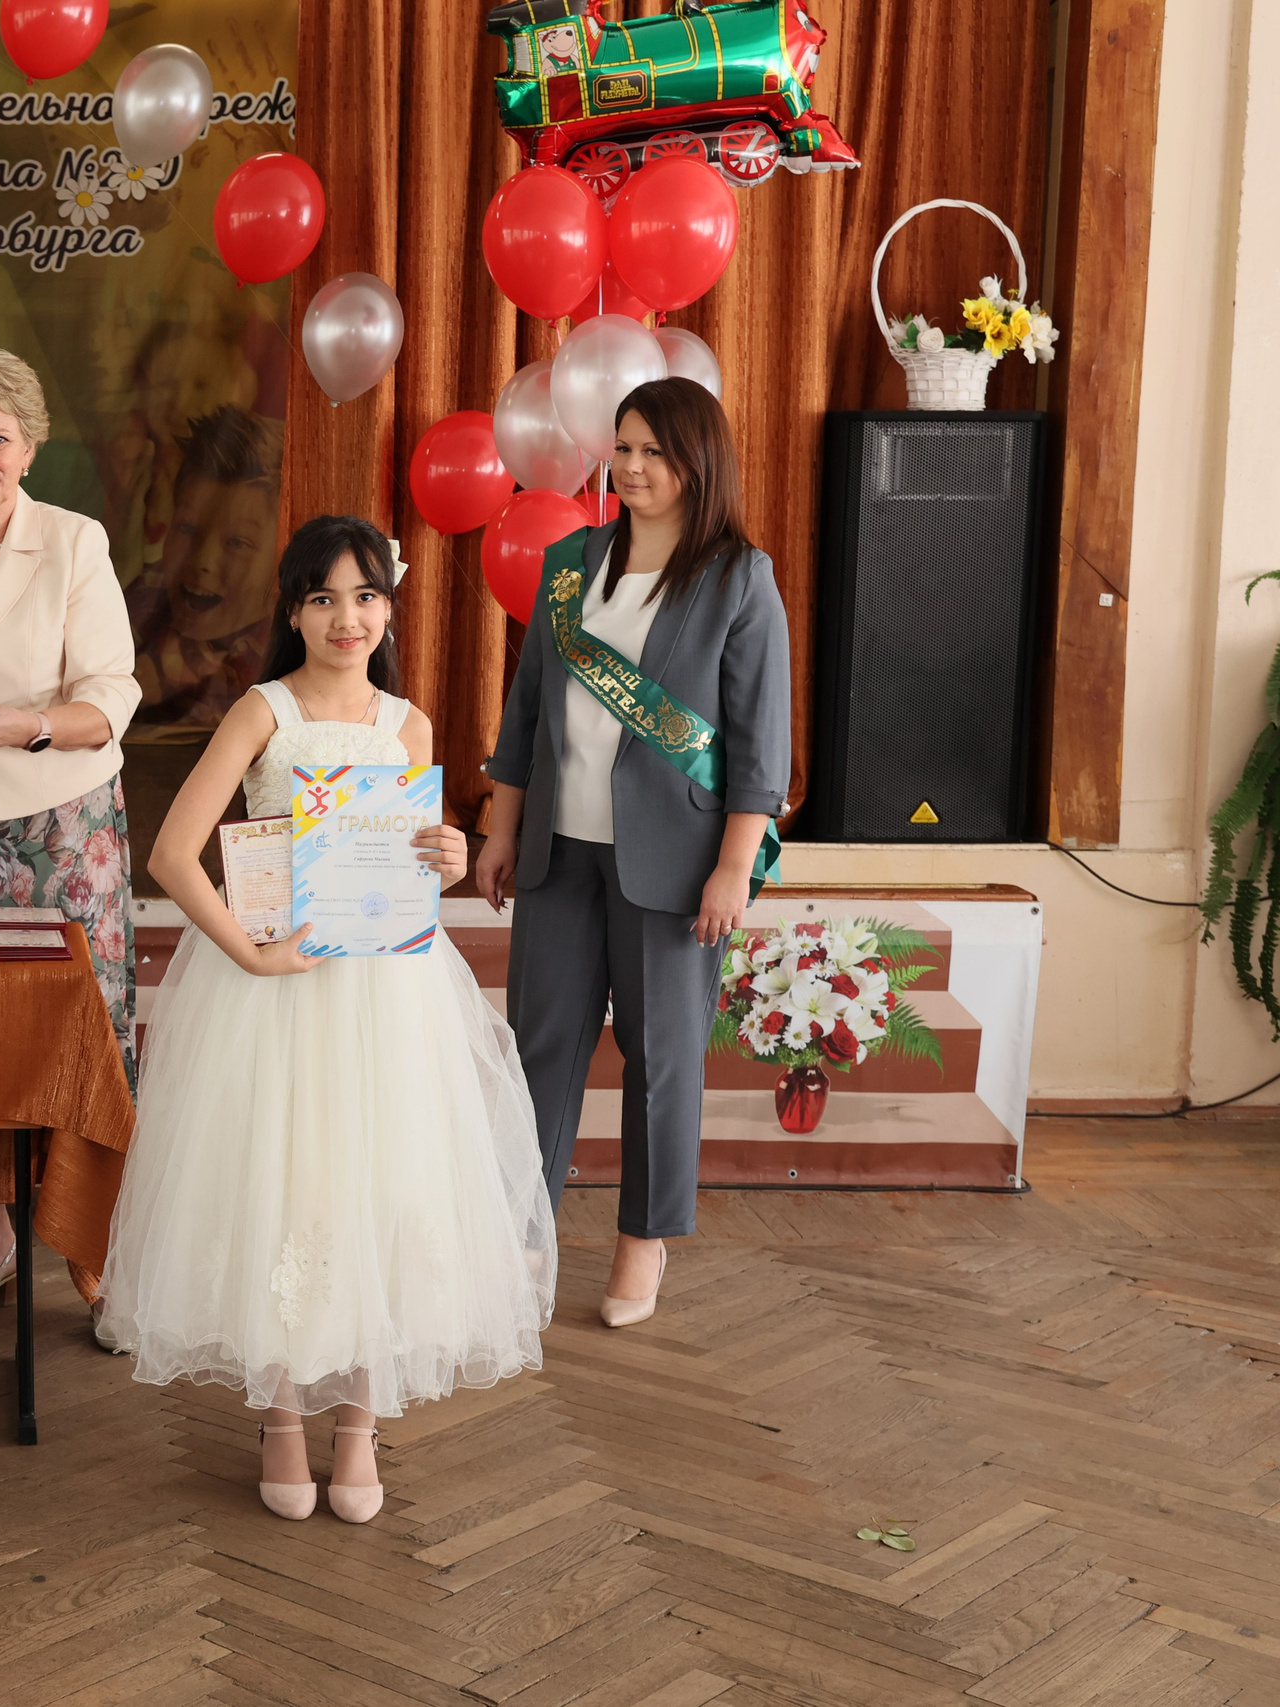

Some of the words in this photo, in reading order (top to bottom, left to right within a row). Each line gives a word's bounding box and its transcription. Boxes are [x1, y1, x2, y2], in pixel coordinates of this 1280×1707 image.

[200, 79, 296, 137] реж
[55, 147, 182, 189] №2
[337, 814, 431, 833] ГРАМОТА
